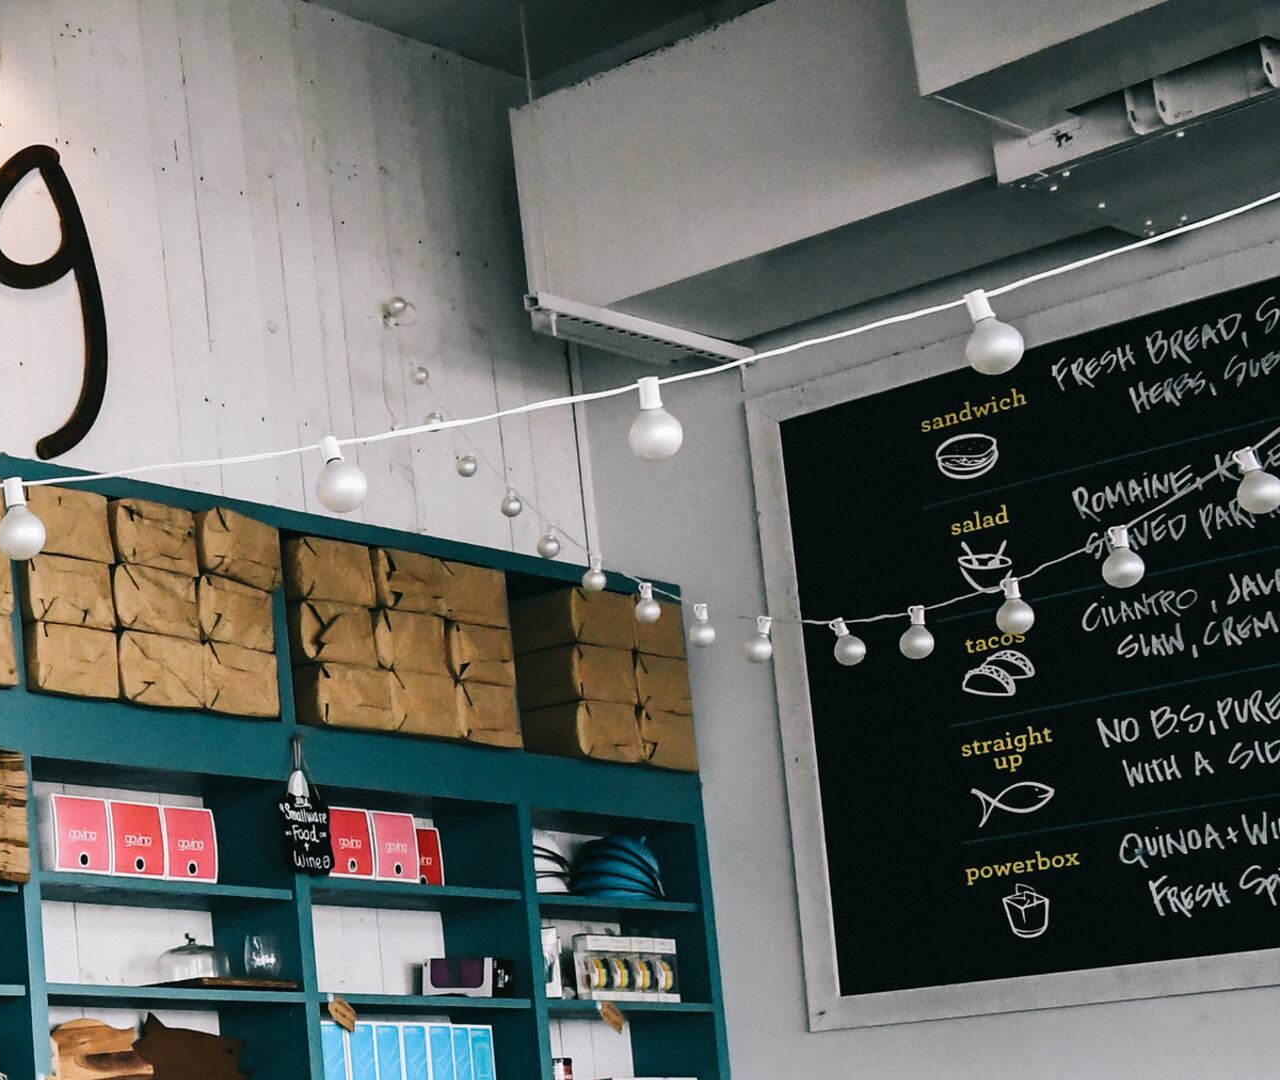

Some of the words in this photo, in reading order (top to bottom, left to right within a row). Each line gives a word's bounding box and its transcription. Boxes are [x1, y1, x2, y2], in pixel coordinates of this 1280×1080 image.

[1052, 344, 1136, 391] FRESH
[1146, 313, 1248, 366] BREAD,
[1129, 371, 1217, 413] HERBS,
[920, 388, 1028, 433] sandwich
[950, 505, 1010, 536] salad
[965, 632, 1026, 654] tacos
[1117, 623, 1198, 658] SLAW,
[961, 725, 1053, 757] straight
[1096, 717, 1140, 748] NO
[993, 753, 1023, 772] up
[1123, 755, 1181, 790] WITH
[1195, 751, 1215, 776] A
[124, 833, 153, 848] govino
[177, 837, 205, 852] govino
[292, 824, 320, 843] Food
[293, 850, 322, 869] Wine
[965, 851, 1080, 885] powerbox
[1149, 873, 1232, 917] FRESH
